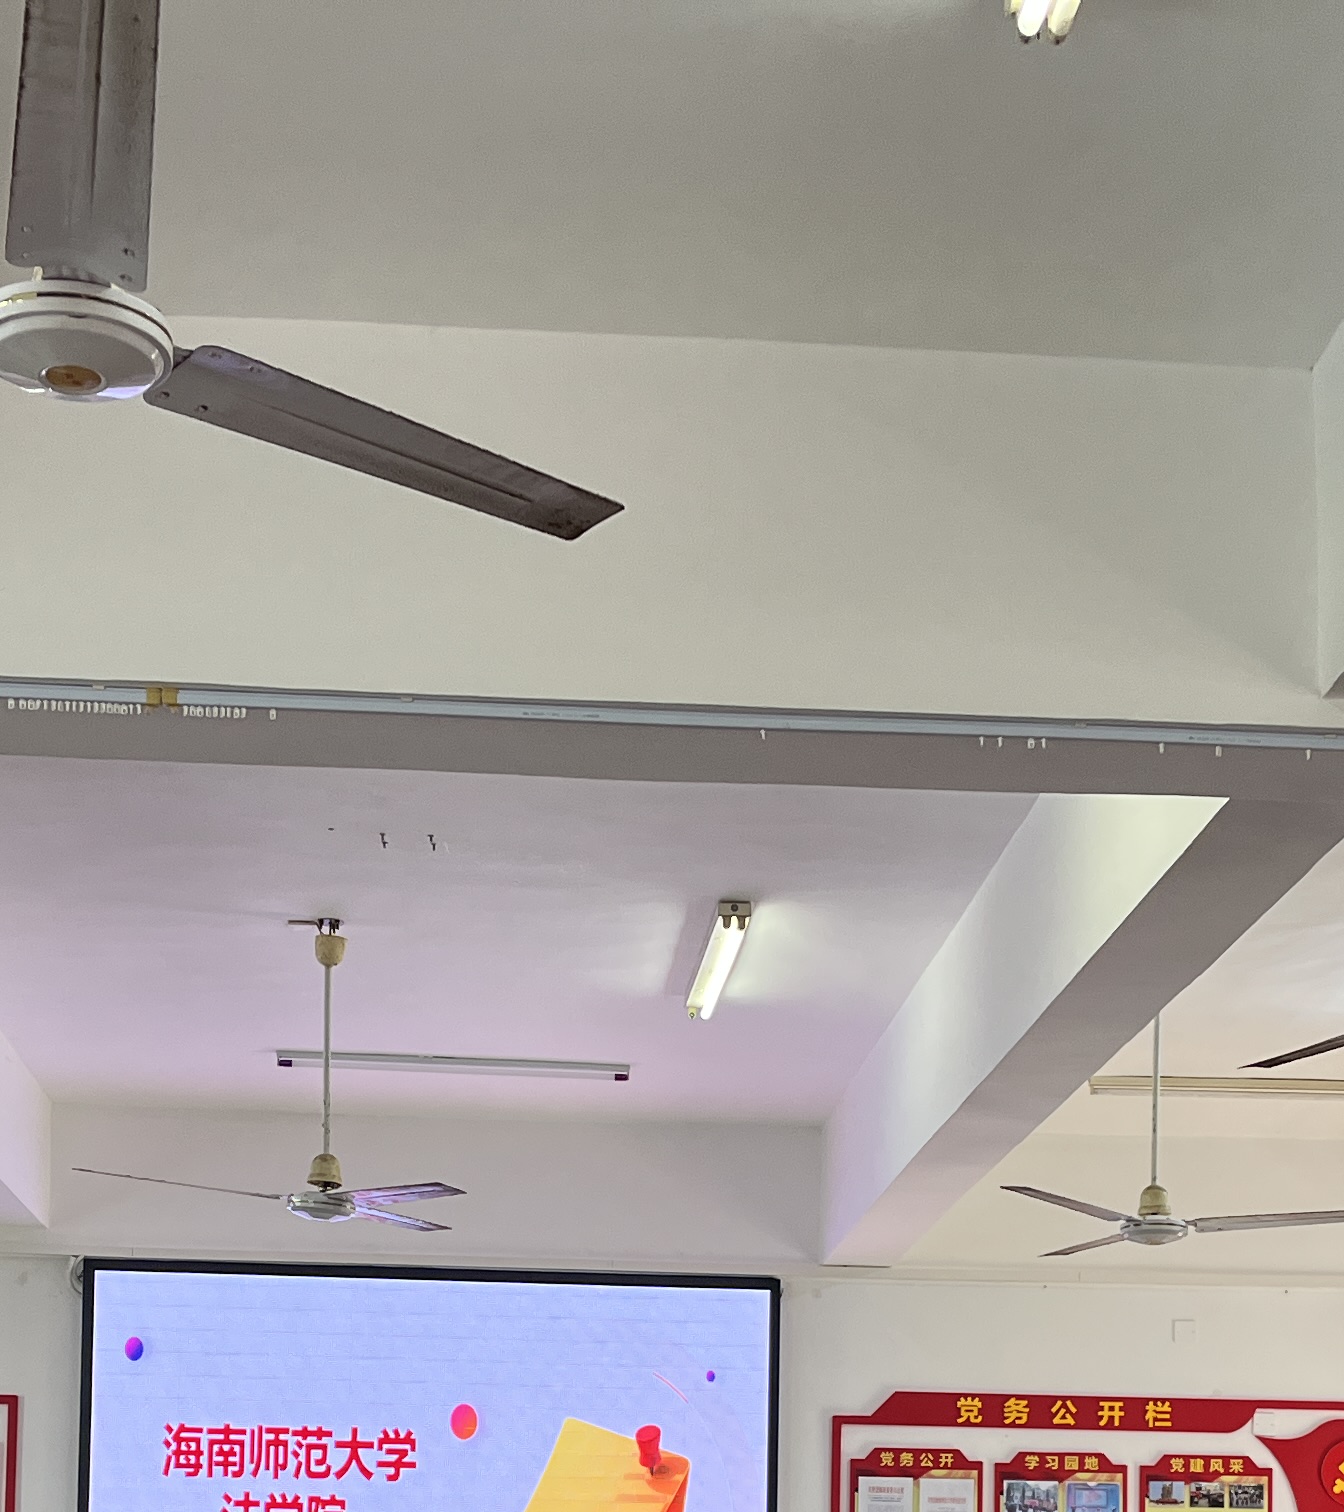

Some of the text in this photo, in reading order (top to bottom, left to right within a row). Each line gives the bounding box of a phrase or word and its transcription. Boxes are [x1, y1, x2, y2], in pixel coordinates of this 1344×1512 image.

[956, 1396, 1173, 1428] 党务公开栏
[162, 1423, 417, 1482] 海南师范大学
[879, 1451, 955, 1467] 党务公开
[1024, 1455, 1099, 1471] 学习园地
[1170, 1457, 1245, 1473] 党建风采
